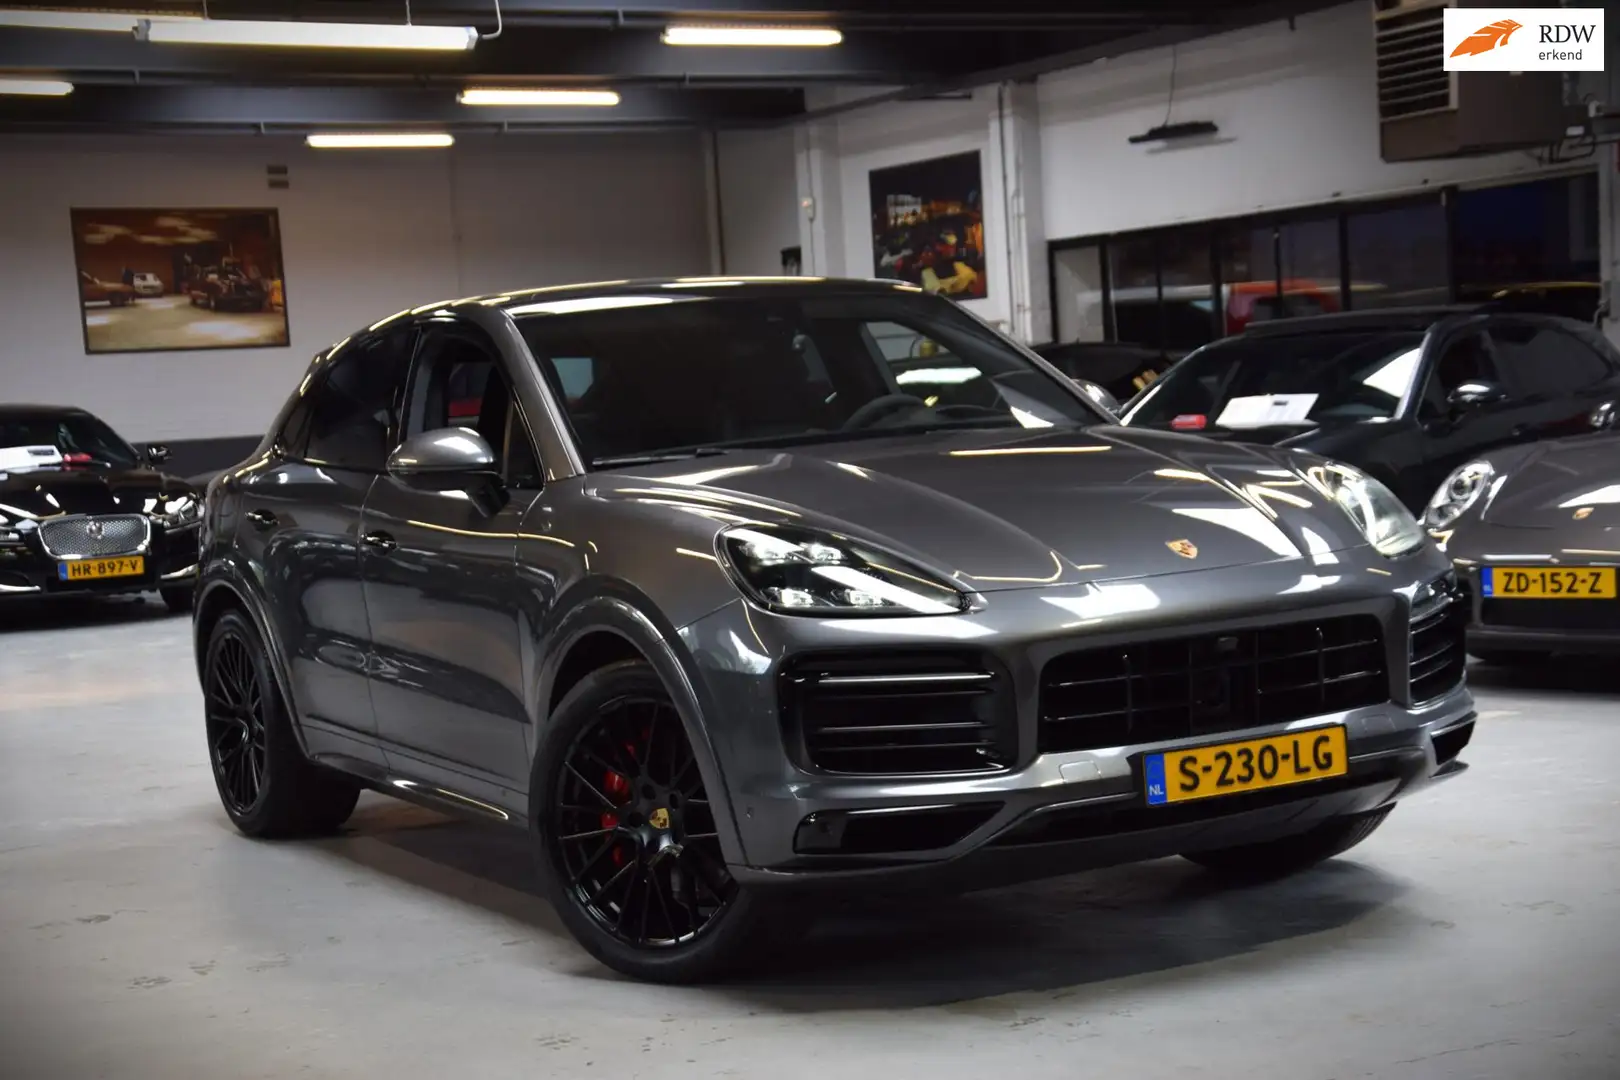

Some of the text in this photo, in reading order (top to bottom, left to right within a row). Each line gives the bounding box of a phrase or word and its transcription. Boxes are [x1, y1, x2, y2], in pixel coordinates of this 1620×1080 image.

[71, 559, 138, 577] HR-897-V
[1503, 571, 1603, 593] ZD-152-Z
[1178, 735, 1333, 792] S-230-LG
[1149, 784, 1164, 796] NL
